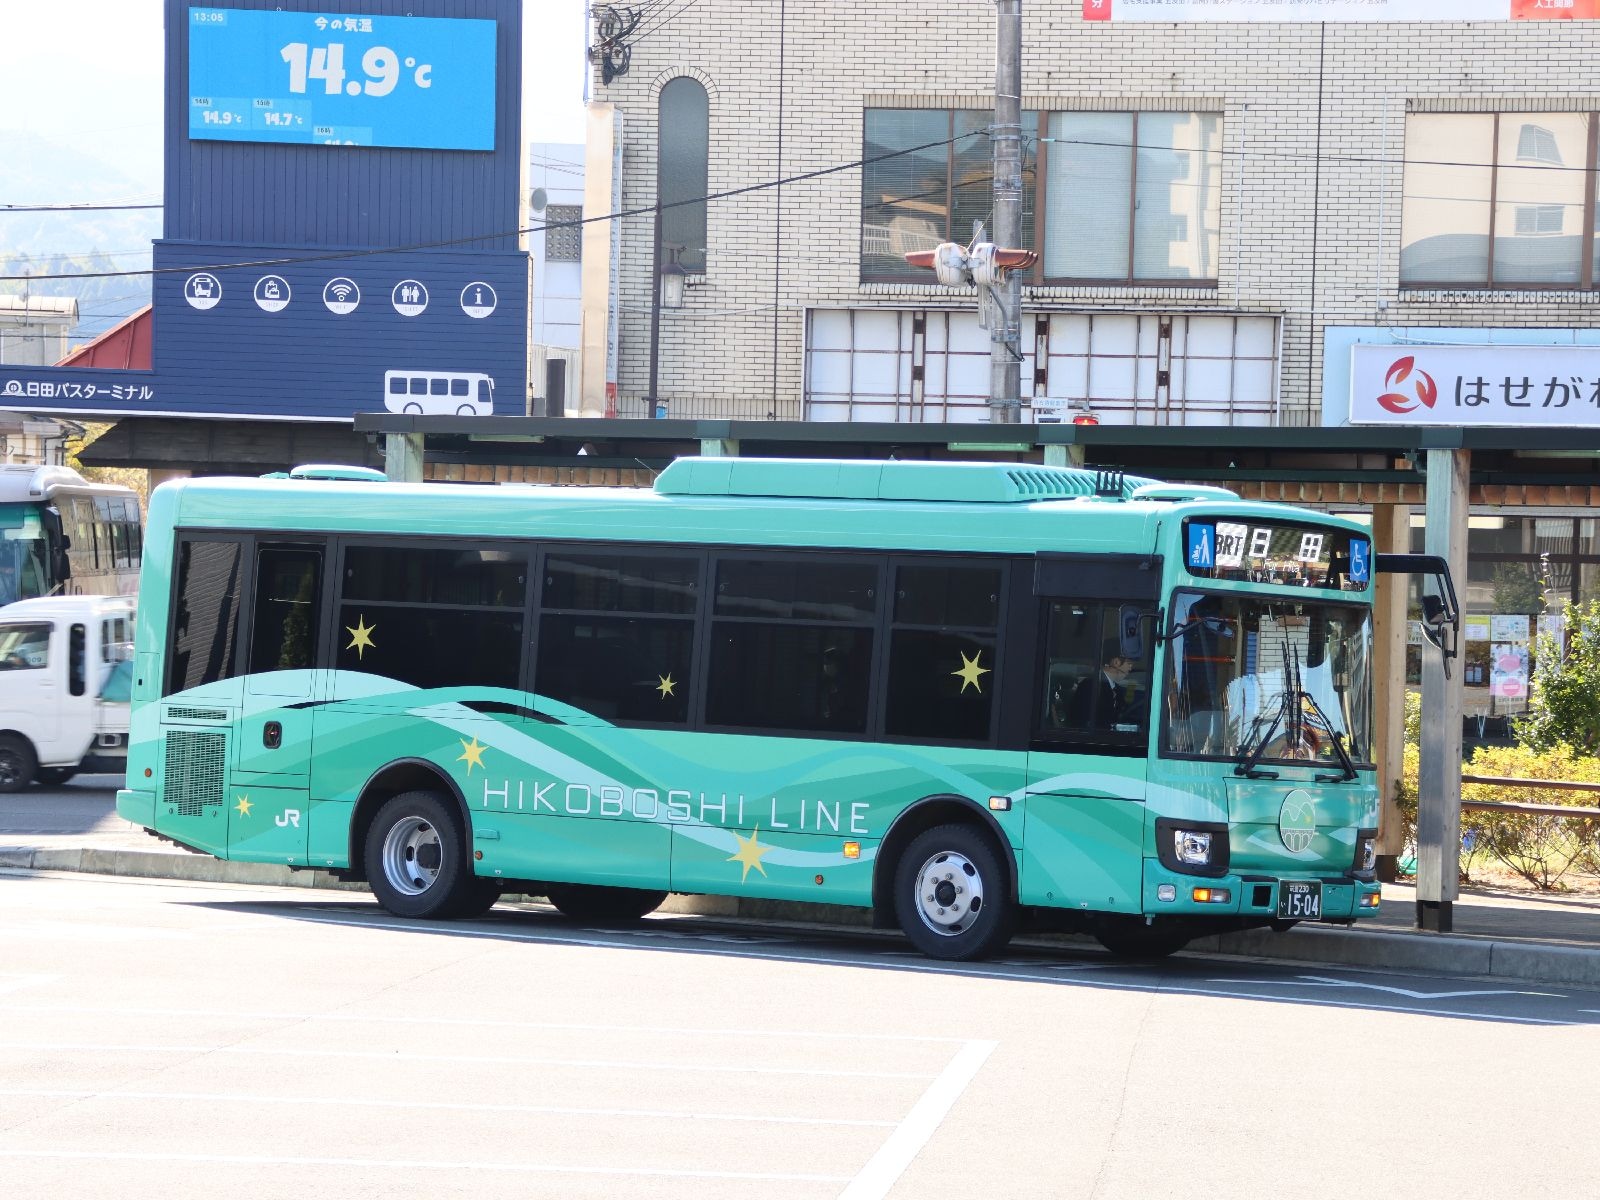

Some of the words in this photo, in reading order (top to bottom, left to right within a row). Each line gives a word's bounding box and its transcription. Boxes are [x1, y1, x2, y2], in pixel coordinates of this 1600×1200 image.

[194, 12, 224, 22] 13:05
[314, 16, 373, 33] 今の気温
[27, 382, 154, 400] 日田バスターミナル
[1216, 533, 1244, 557] BRT
[483, 778, 745, 824] HIKOBOSHI
[770, 796, 870, 834] LINE
[275, 808, 300, 828] JR
